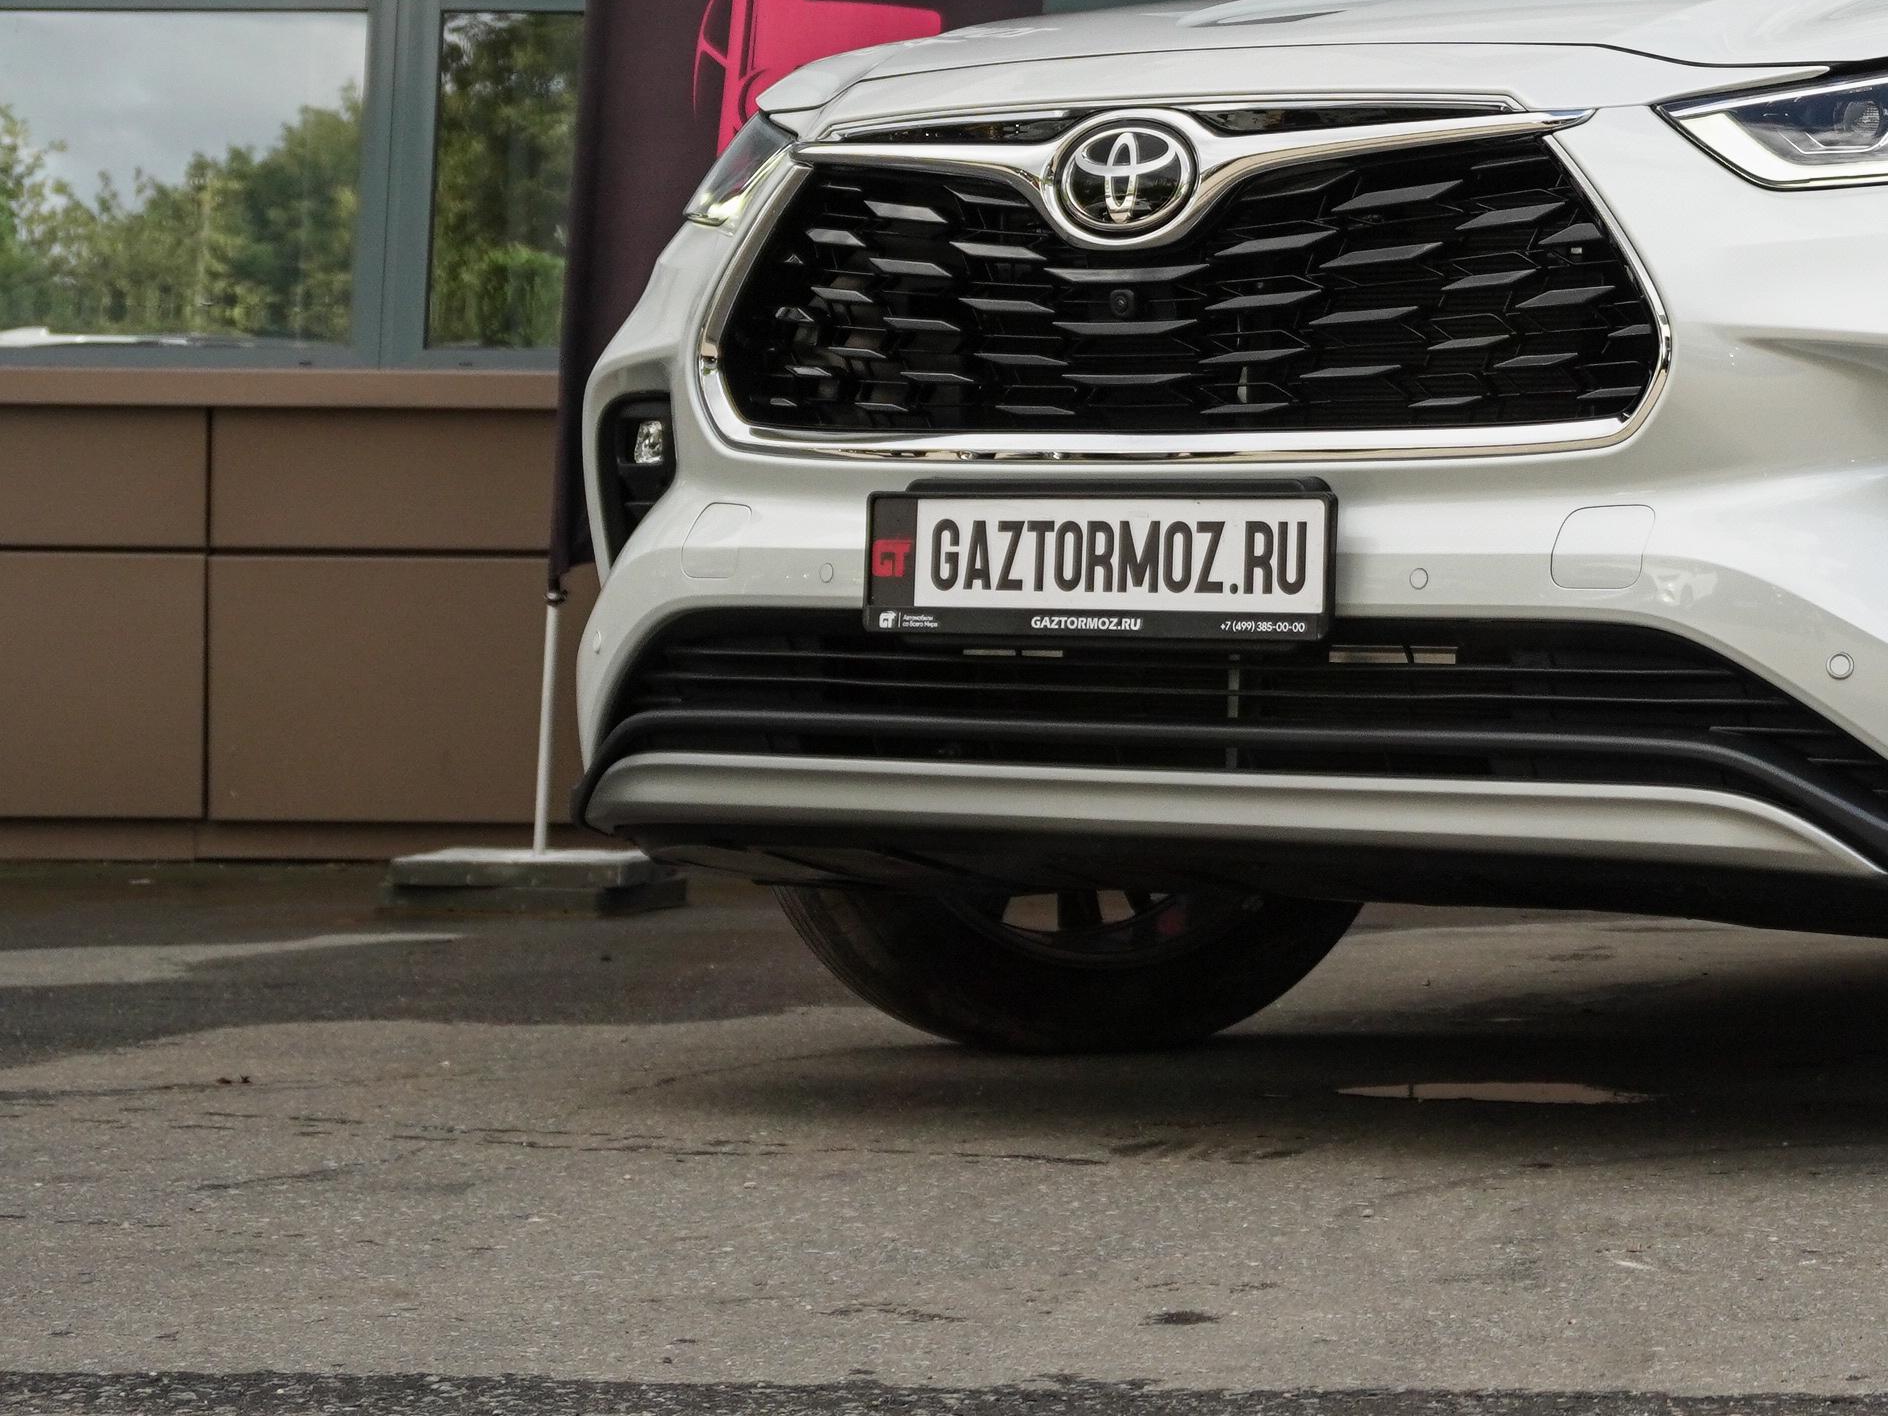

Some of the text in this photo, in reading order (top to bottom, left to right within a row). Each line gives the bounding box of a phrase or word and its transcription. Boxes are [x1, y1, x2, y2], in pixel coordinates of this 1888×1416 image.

[872, 539, 911, 577] GT
[930, 518, 1308, 596] GAZTORMOZ.RU
[1030, 616, 1142, 631] GAZTORMOZ.RU
[1232, 620, 1256, 632] (499)
[1256, 621, 1306, 633] 385-00-00
